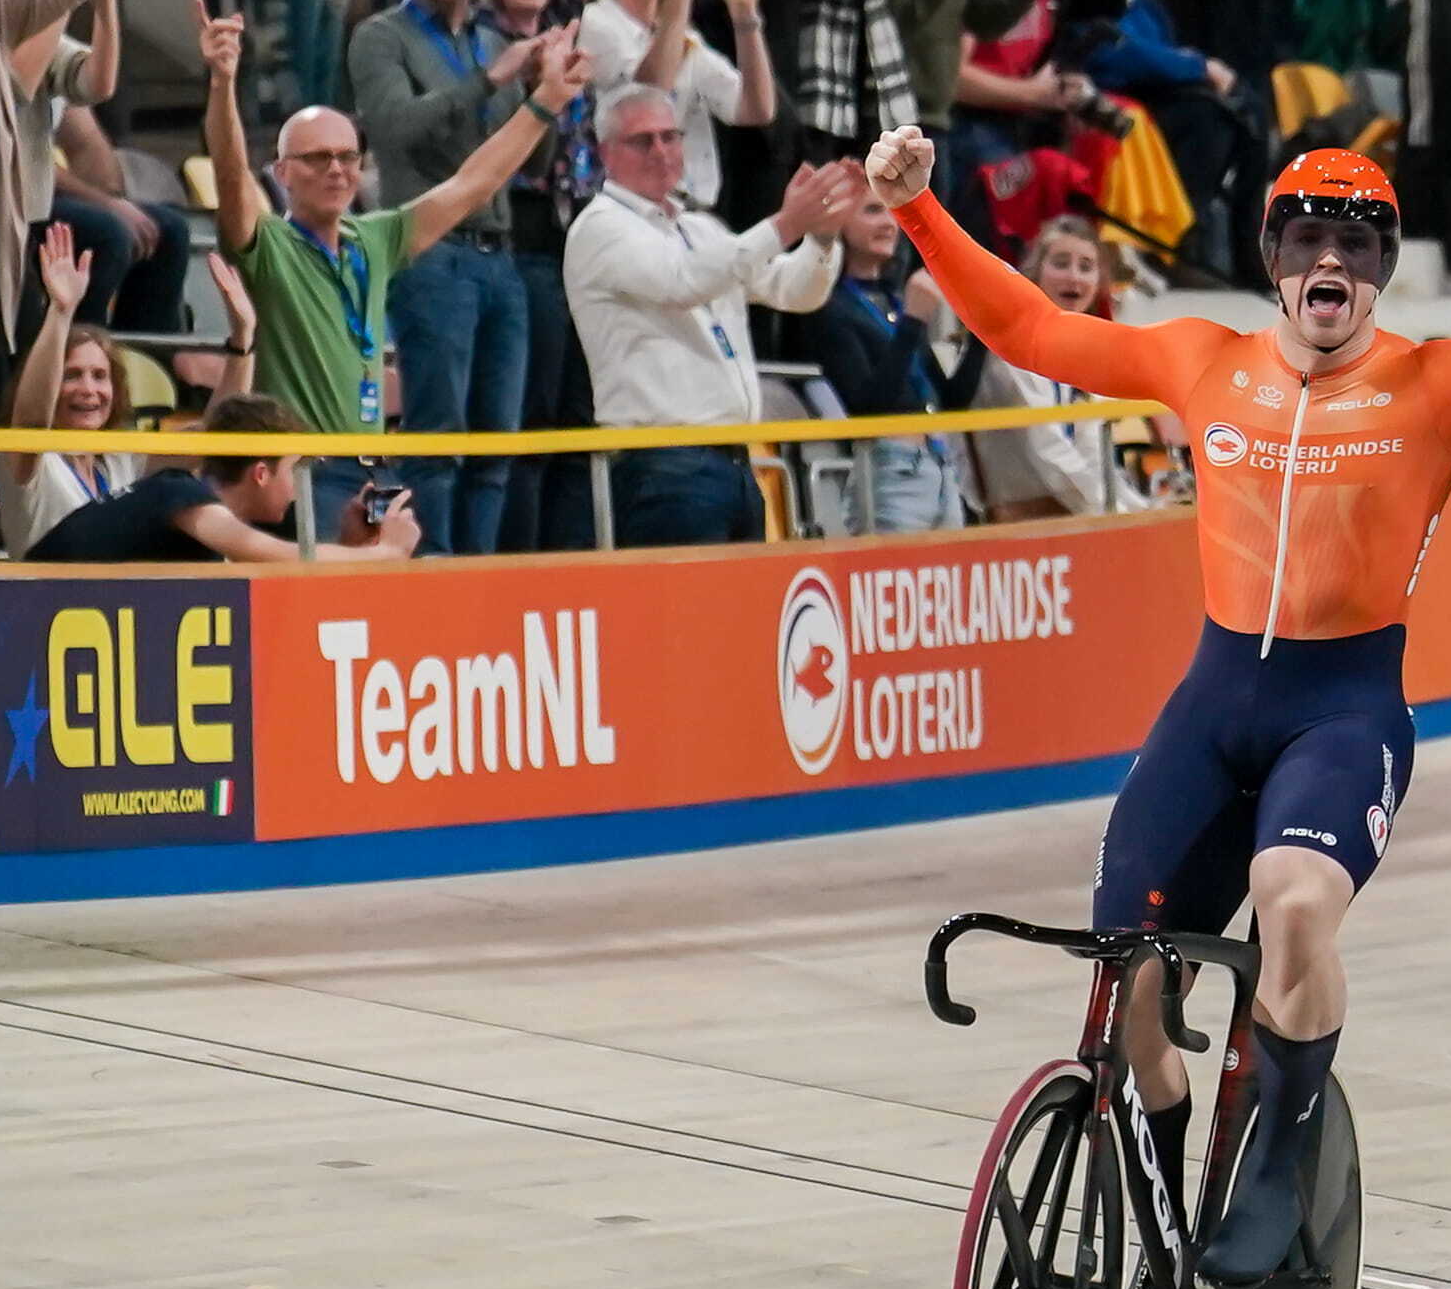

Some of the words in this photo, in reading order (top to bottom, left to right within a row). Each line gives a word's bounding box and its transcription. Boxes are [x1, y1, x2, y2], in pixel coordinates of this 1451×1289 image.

[1252, 438, 1404, 460] NEDERLANDSE
[1249, 454, 1338, 475] LOTERIJ
[849, 556, 1074, 656] NEDERLANDSE
[318, 609, 617, 785] TeamNL
[853, 668, 984, 762] LOTERIJ
[82, 787, 205, 817] WWW.ALECYCLING.COM
[1281, 827, 1322, 840] AGU
